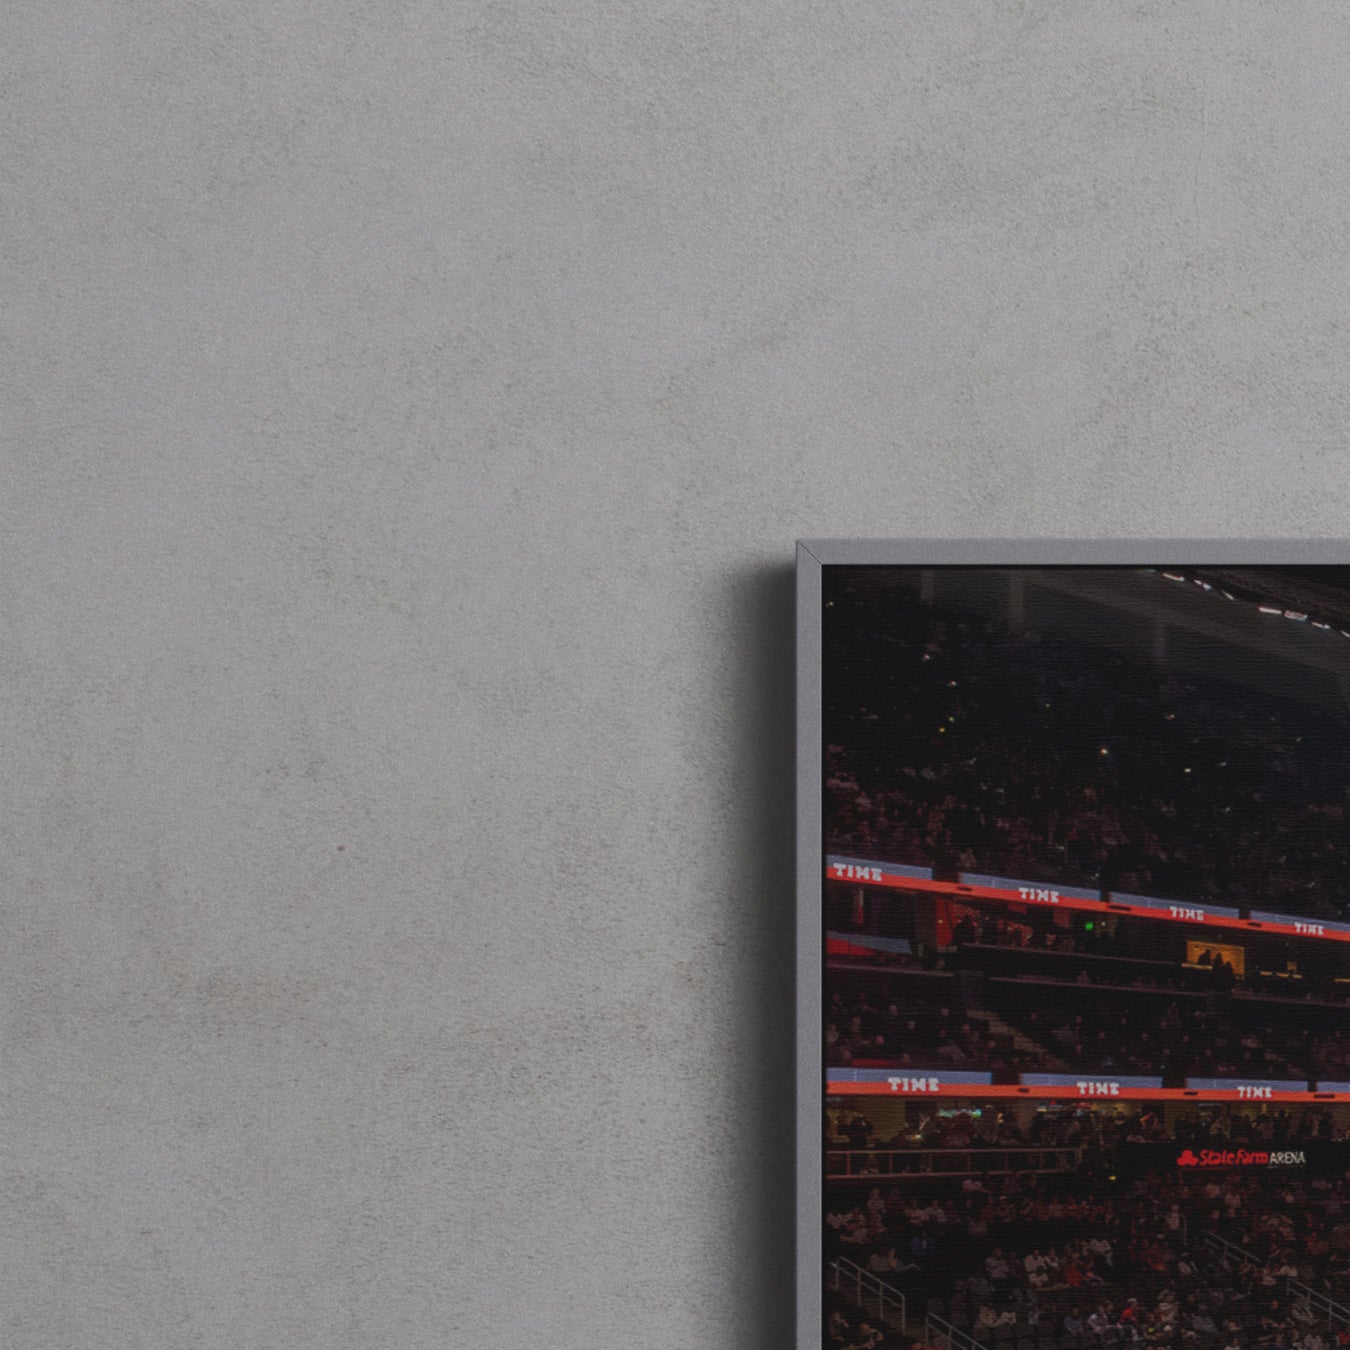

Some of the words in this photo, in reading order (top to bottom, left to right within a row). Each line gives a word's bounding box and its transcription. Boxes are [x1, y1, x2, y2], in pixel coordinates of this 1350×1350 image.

[834, 863, 882, 881] TIME
[1019, 887, 1059, 903] TIME
[1170, 906, 1203, 921] TIME
[1294, 923, 1323, 936] TIME
[888, 1077, 940, 1092] TIME
[1077, 1082, 1120, 1095] TIME
[1237, 1086, 1272, 1098] TIME
[1269, 1151, 1305, 1164] ARENA
